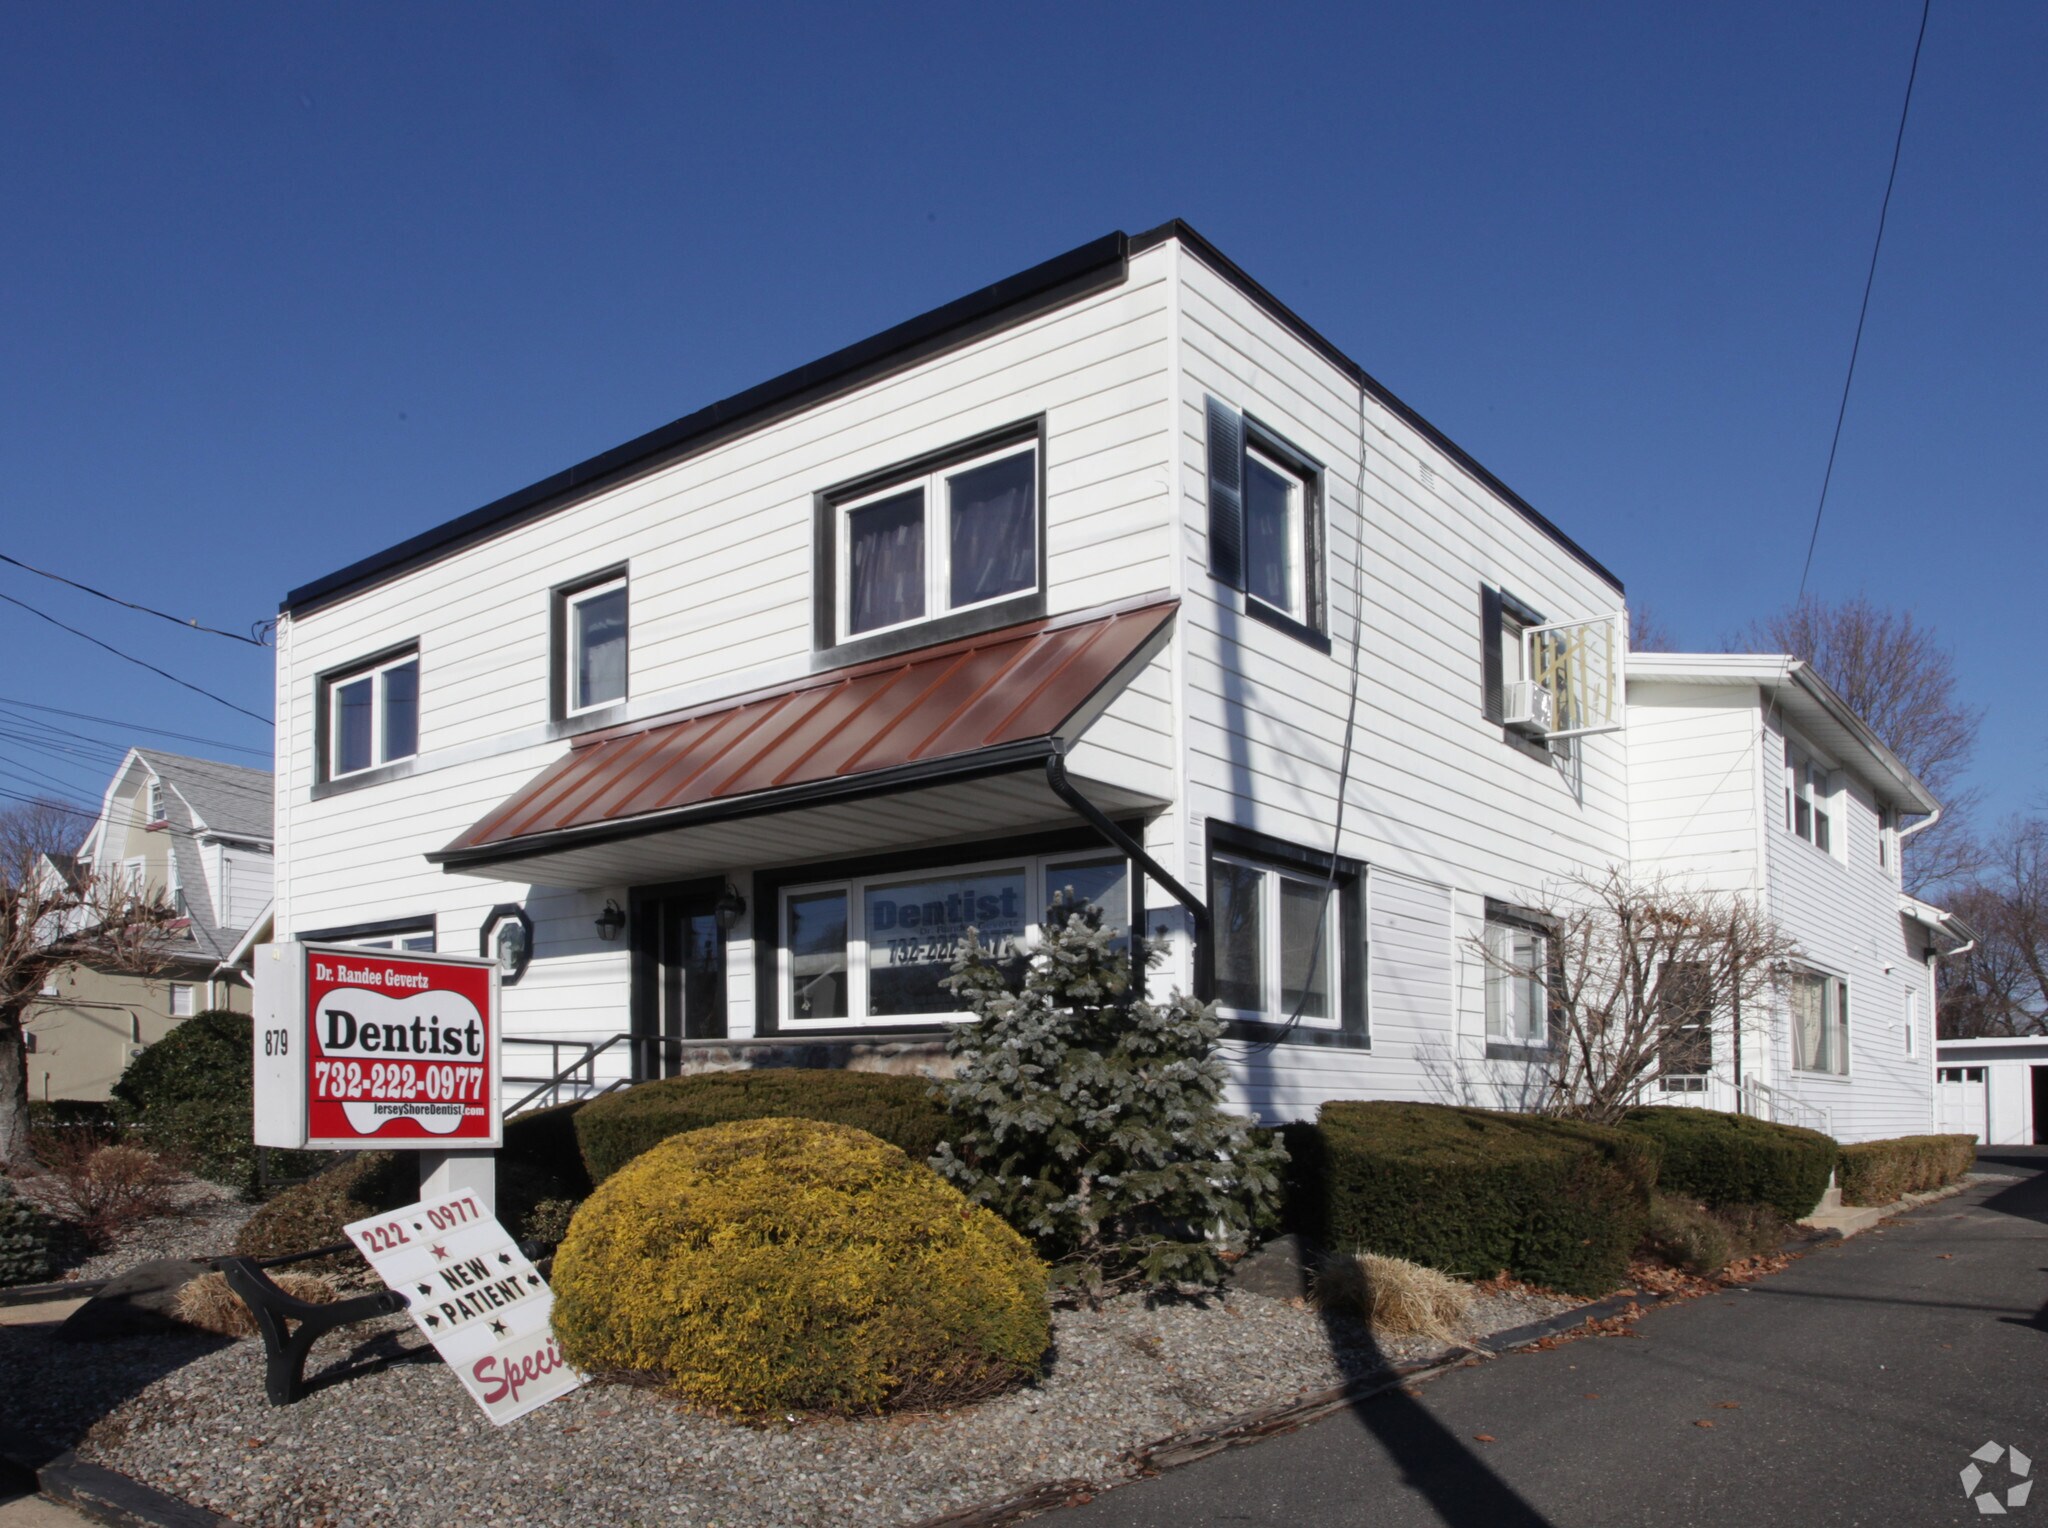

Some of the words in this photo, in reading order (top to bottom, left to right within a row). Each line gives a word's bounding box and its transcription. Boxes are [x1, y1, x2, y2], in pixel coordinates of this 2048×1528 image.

[874, 886, 1018, 931] Dentist
[920, 926, 933, 935] Dr.
[937, 924, 968, 934] Rand
[316, 963, 334, 982] Dr.
[337, 964, 382, 986] Randee
[385, 969, 429, 989] Gevertz
[265, 1028, 288, 1056] 879
[325, 1009, 480, 1057] Dentist
[315, 1061, 484, 1100] 732-222-0977
[373, 1103, 485, 1116] JerseyShoreDentist.com
[361, 1222, 411, 1253] 222
[426, 1197, 479, 1231] 0977
[439, 1257, 491, 1291] NEW
[440, 1275, 525, 1325] PATIENT
[472, 1337, 565, 1404] Speci
